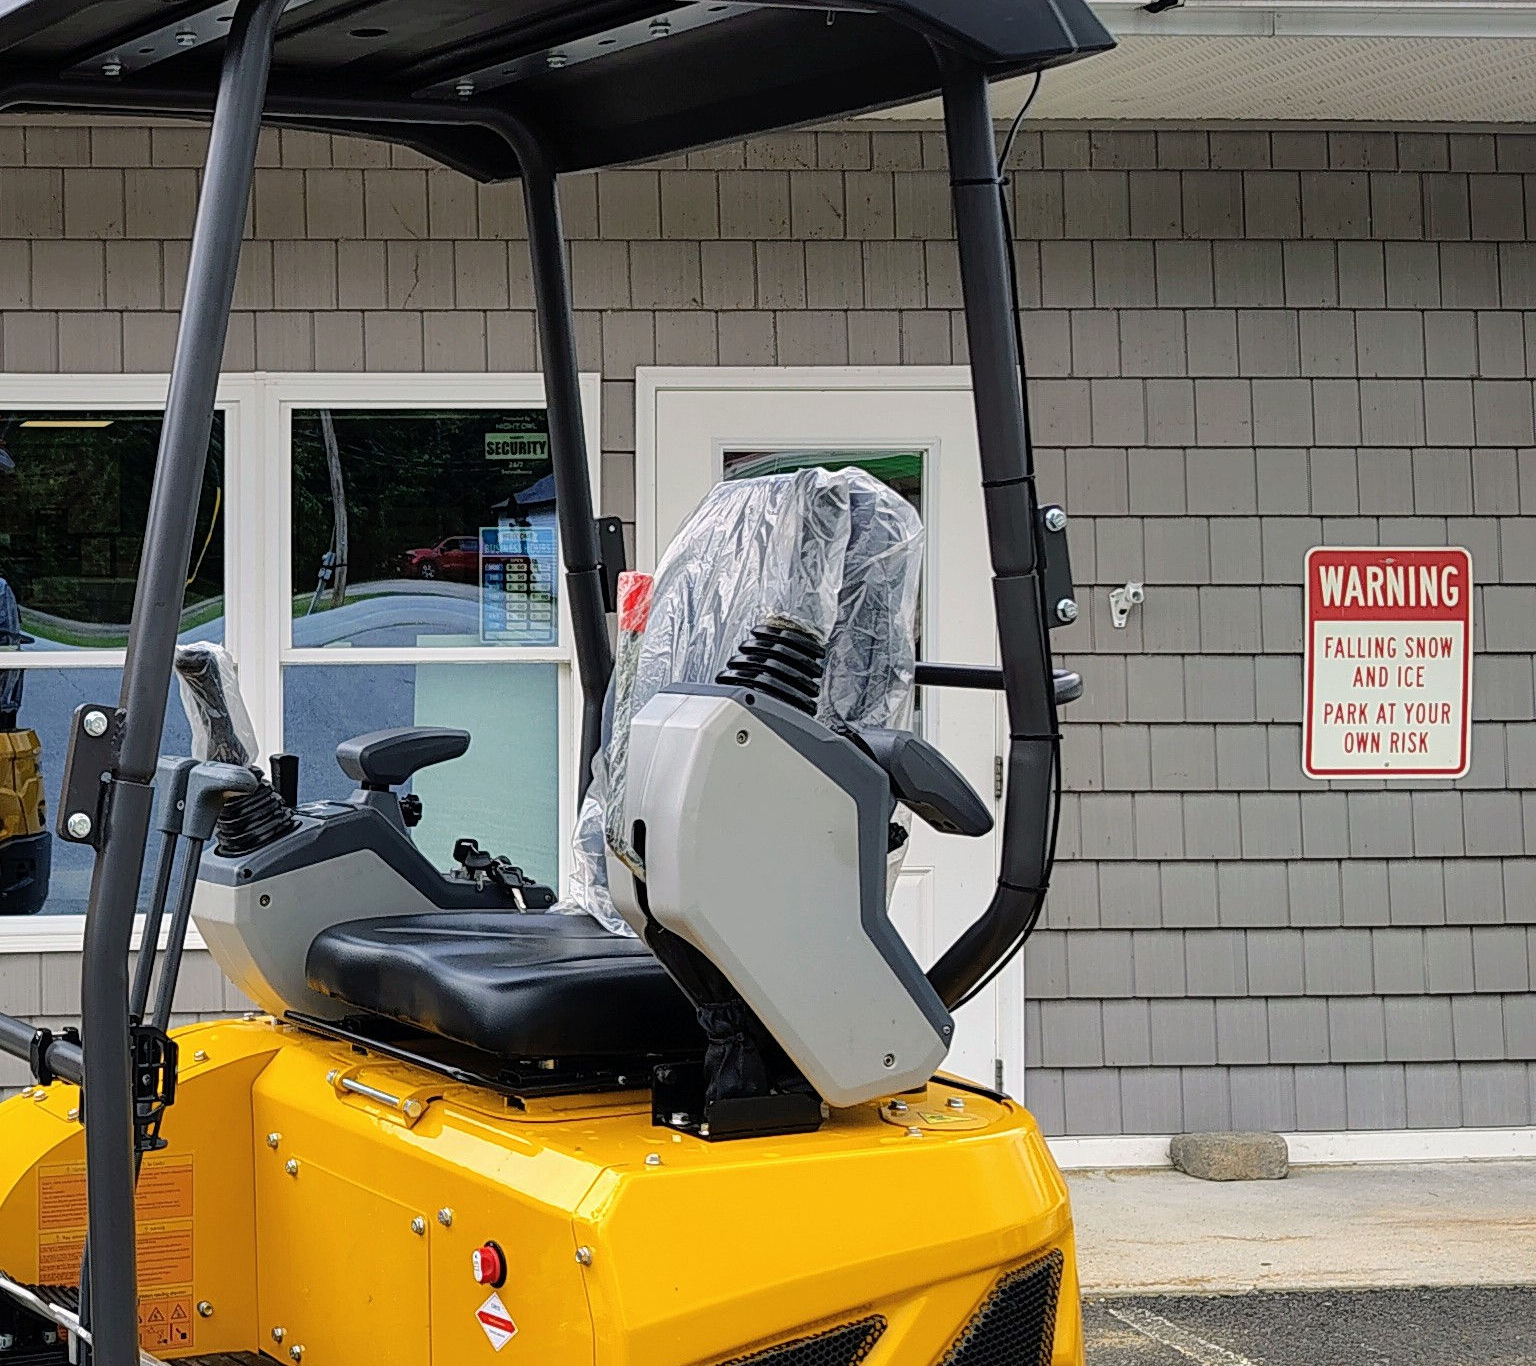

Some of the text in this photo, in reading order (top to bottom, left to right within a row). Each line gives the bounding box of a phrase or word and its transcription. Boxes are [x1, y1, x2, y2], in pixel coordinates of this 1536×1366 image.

[486, 440, 547, 455] SECURITY
[1319, 565, 1459, 607] WARNING
[1324, 637, 1453, 659] FALLING SNOW
[1352, 666, 1425, 688] AND ICE
[1323, 703, 1451, 725] PARK AT YOUR
[1344, 732, 1429, 754] OWN RISK
